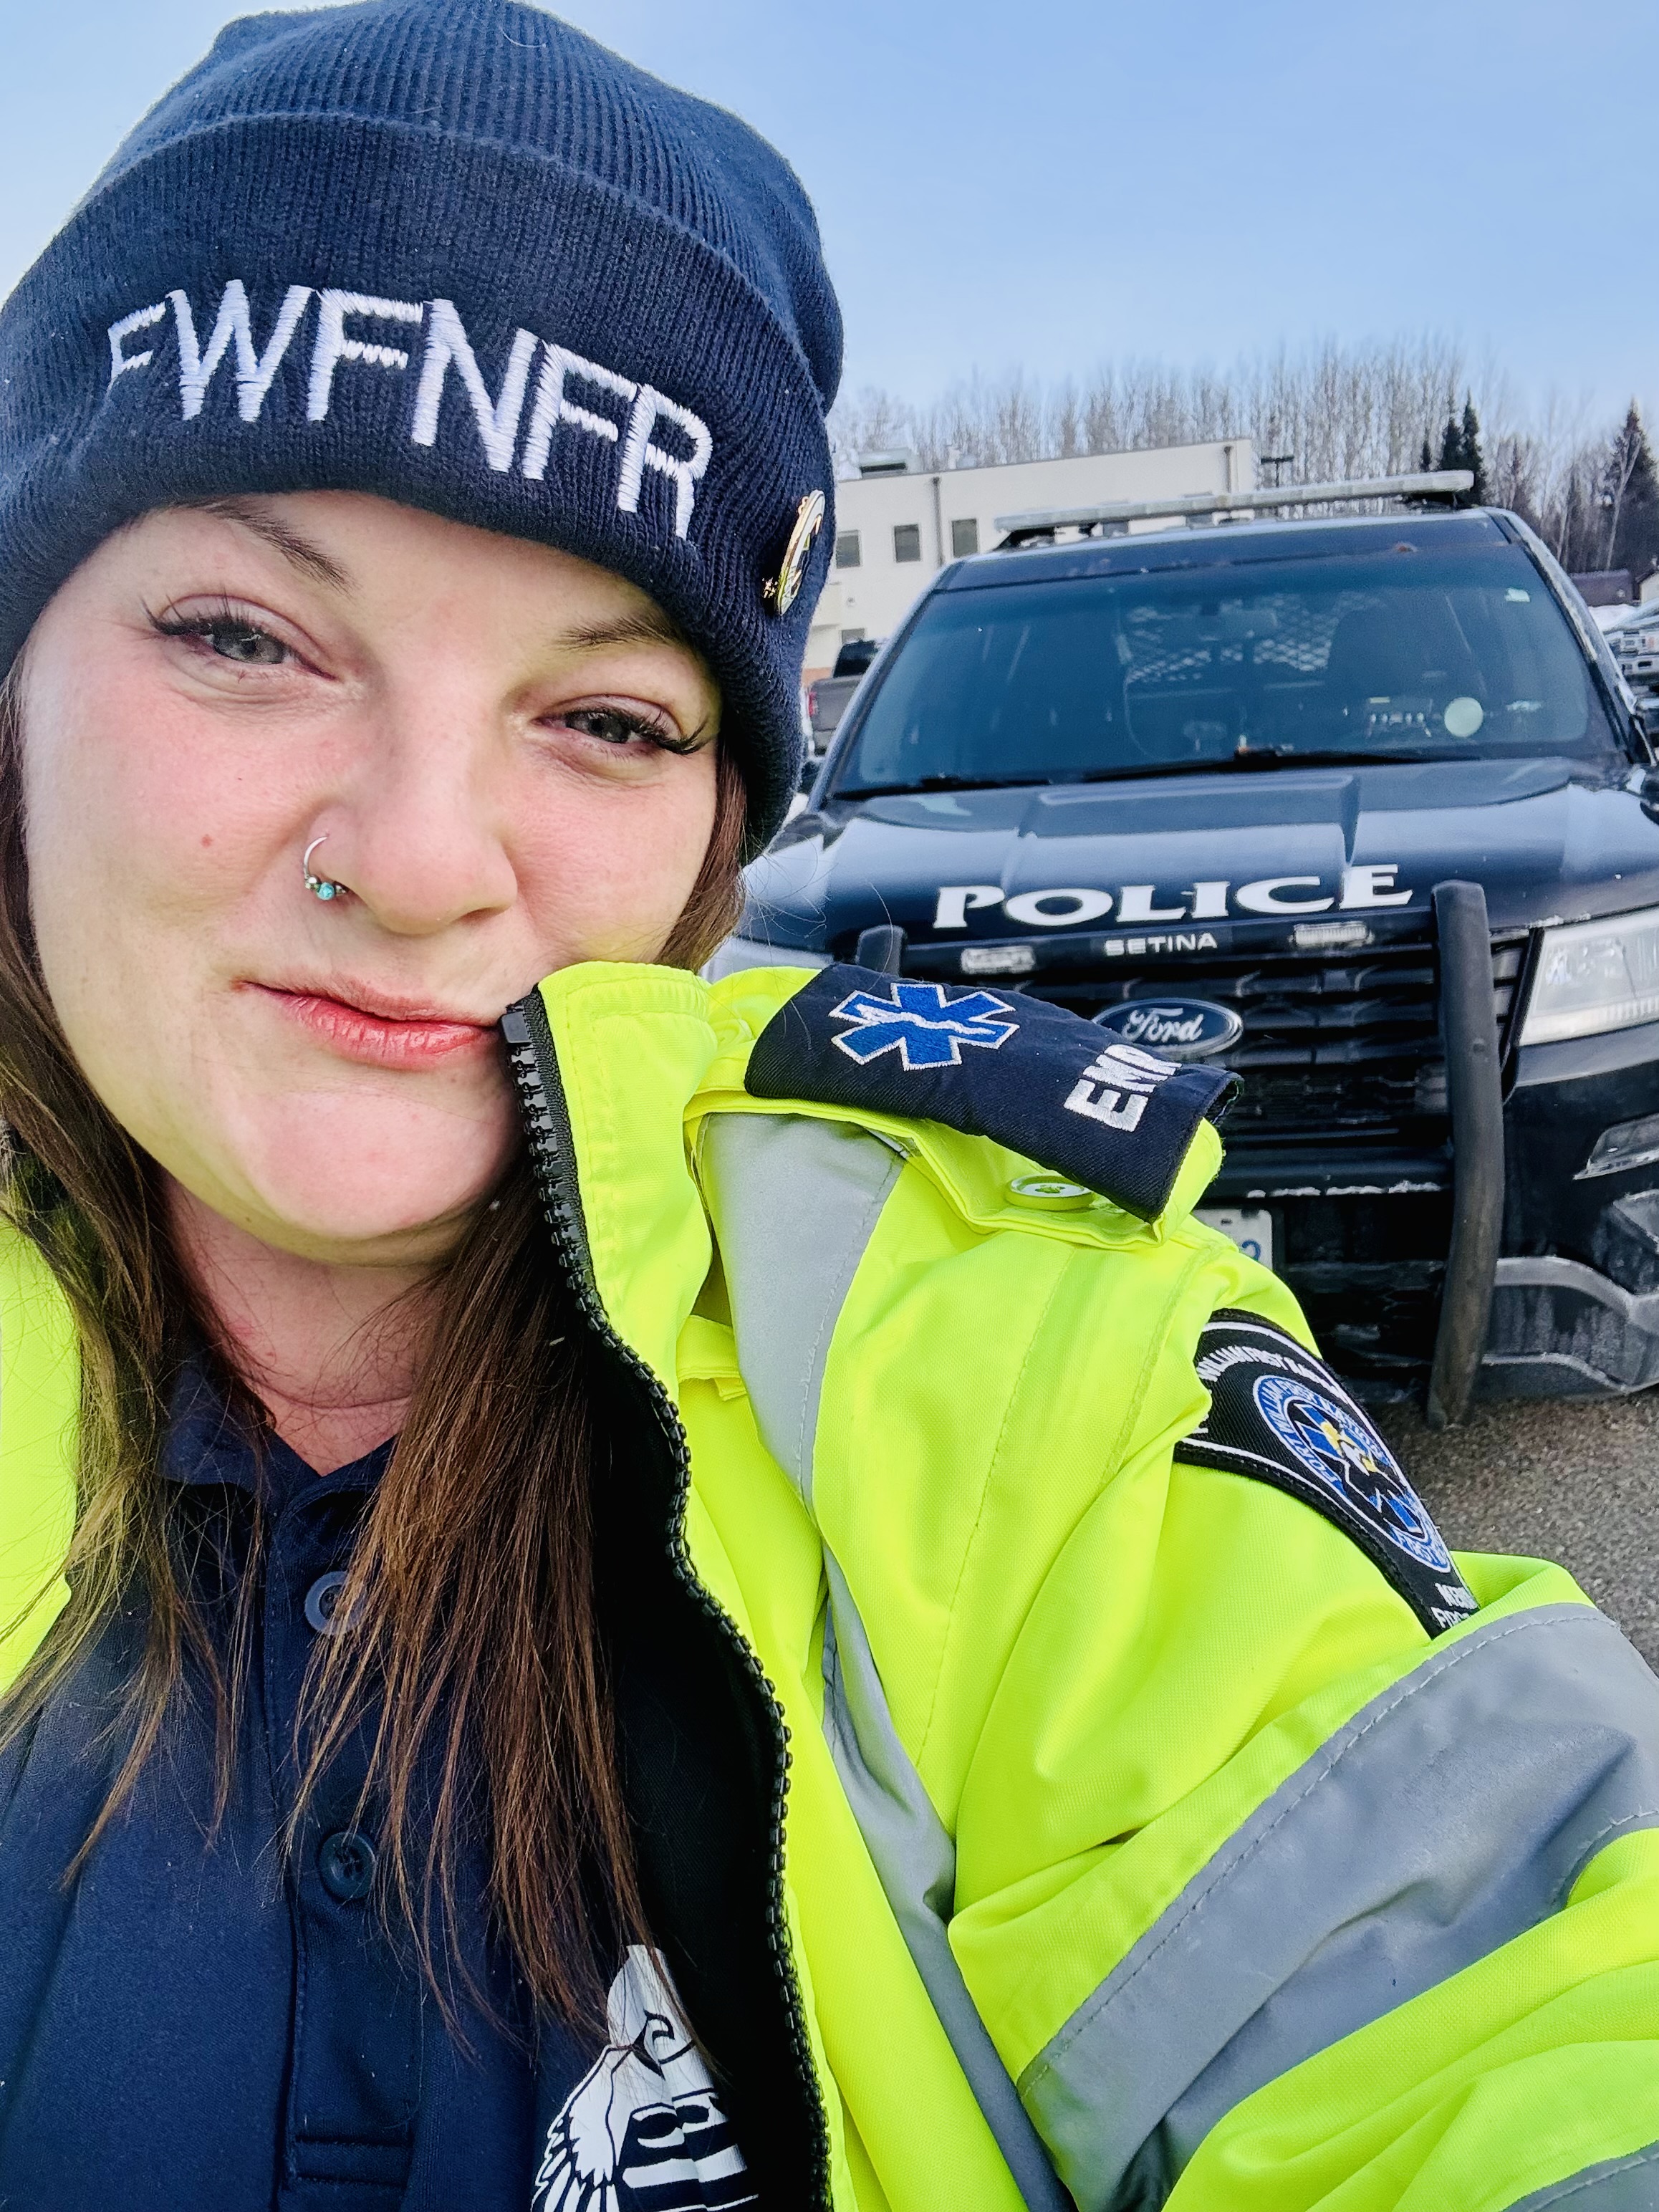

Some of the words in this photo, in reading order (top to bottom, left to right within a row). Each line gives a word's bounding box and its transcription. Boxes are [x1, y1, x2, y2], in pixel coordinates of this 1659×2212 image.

[108, 279, 713, 539] FWFNFR
[933, 864, 1413, 928] POLICE
[1105, 933, 1218, 956] SETINA
[1122, 1007, 1204, 1043] Ford
[1287, 1431, 1337, 1484] FORT
